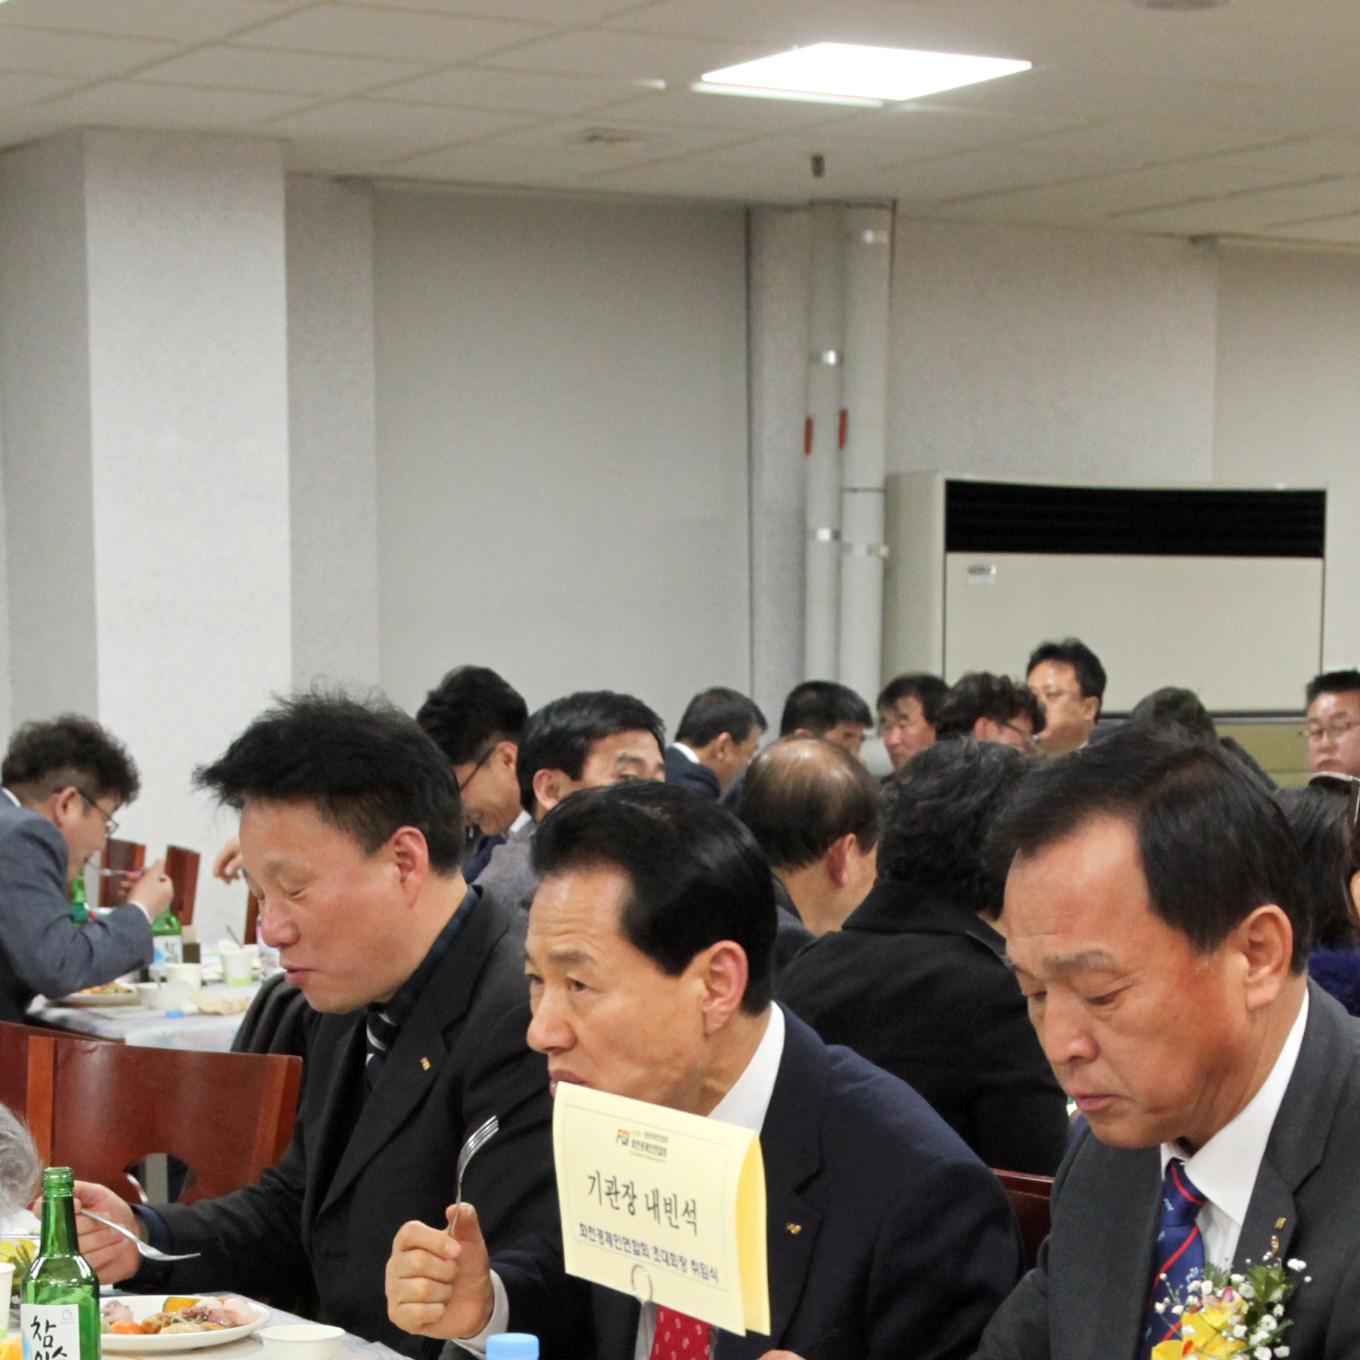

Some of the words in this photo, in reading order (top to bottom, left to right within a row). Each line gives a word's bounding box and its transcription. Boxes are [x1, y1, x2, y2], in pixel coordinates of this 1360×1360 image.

[587, 1170, 637, 1217] 기관장
[644, 1189, 698, 1236] 내빈석
[653, 1245, 688, 1275] 초대회장
[691, 1260, 720, 1284] 취임식
[30, 1315, 56, 1348] 참
